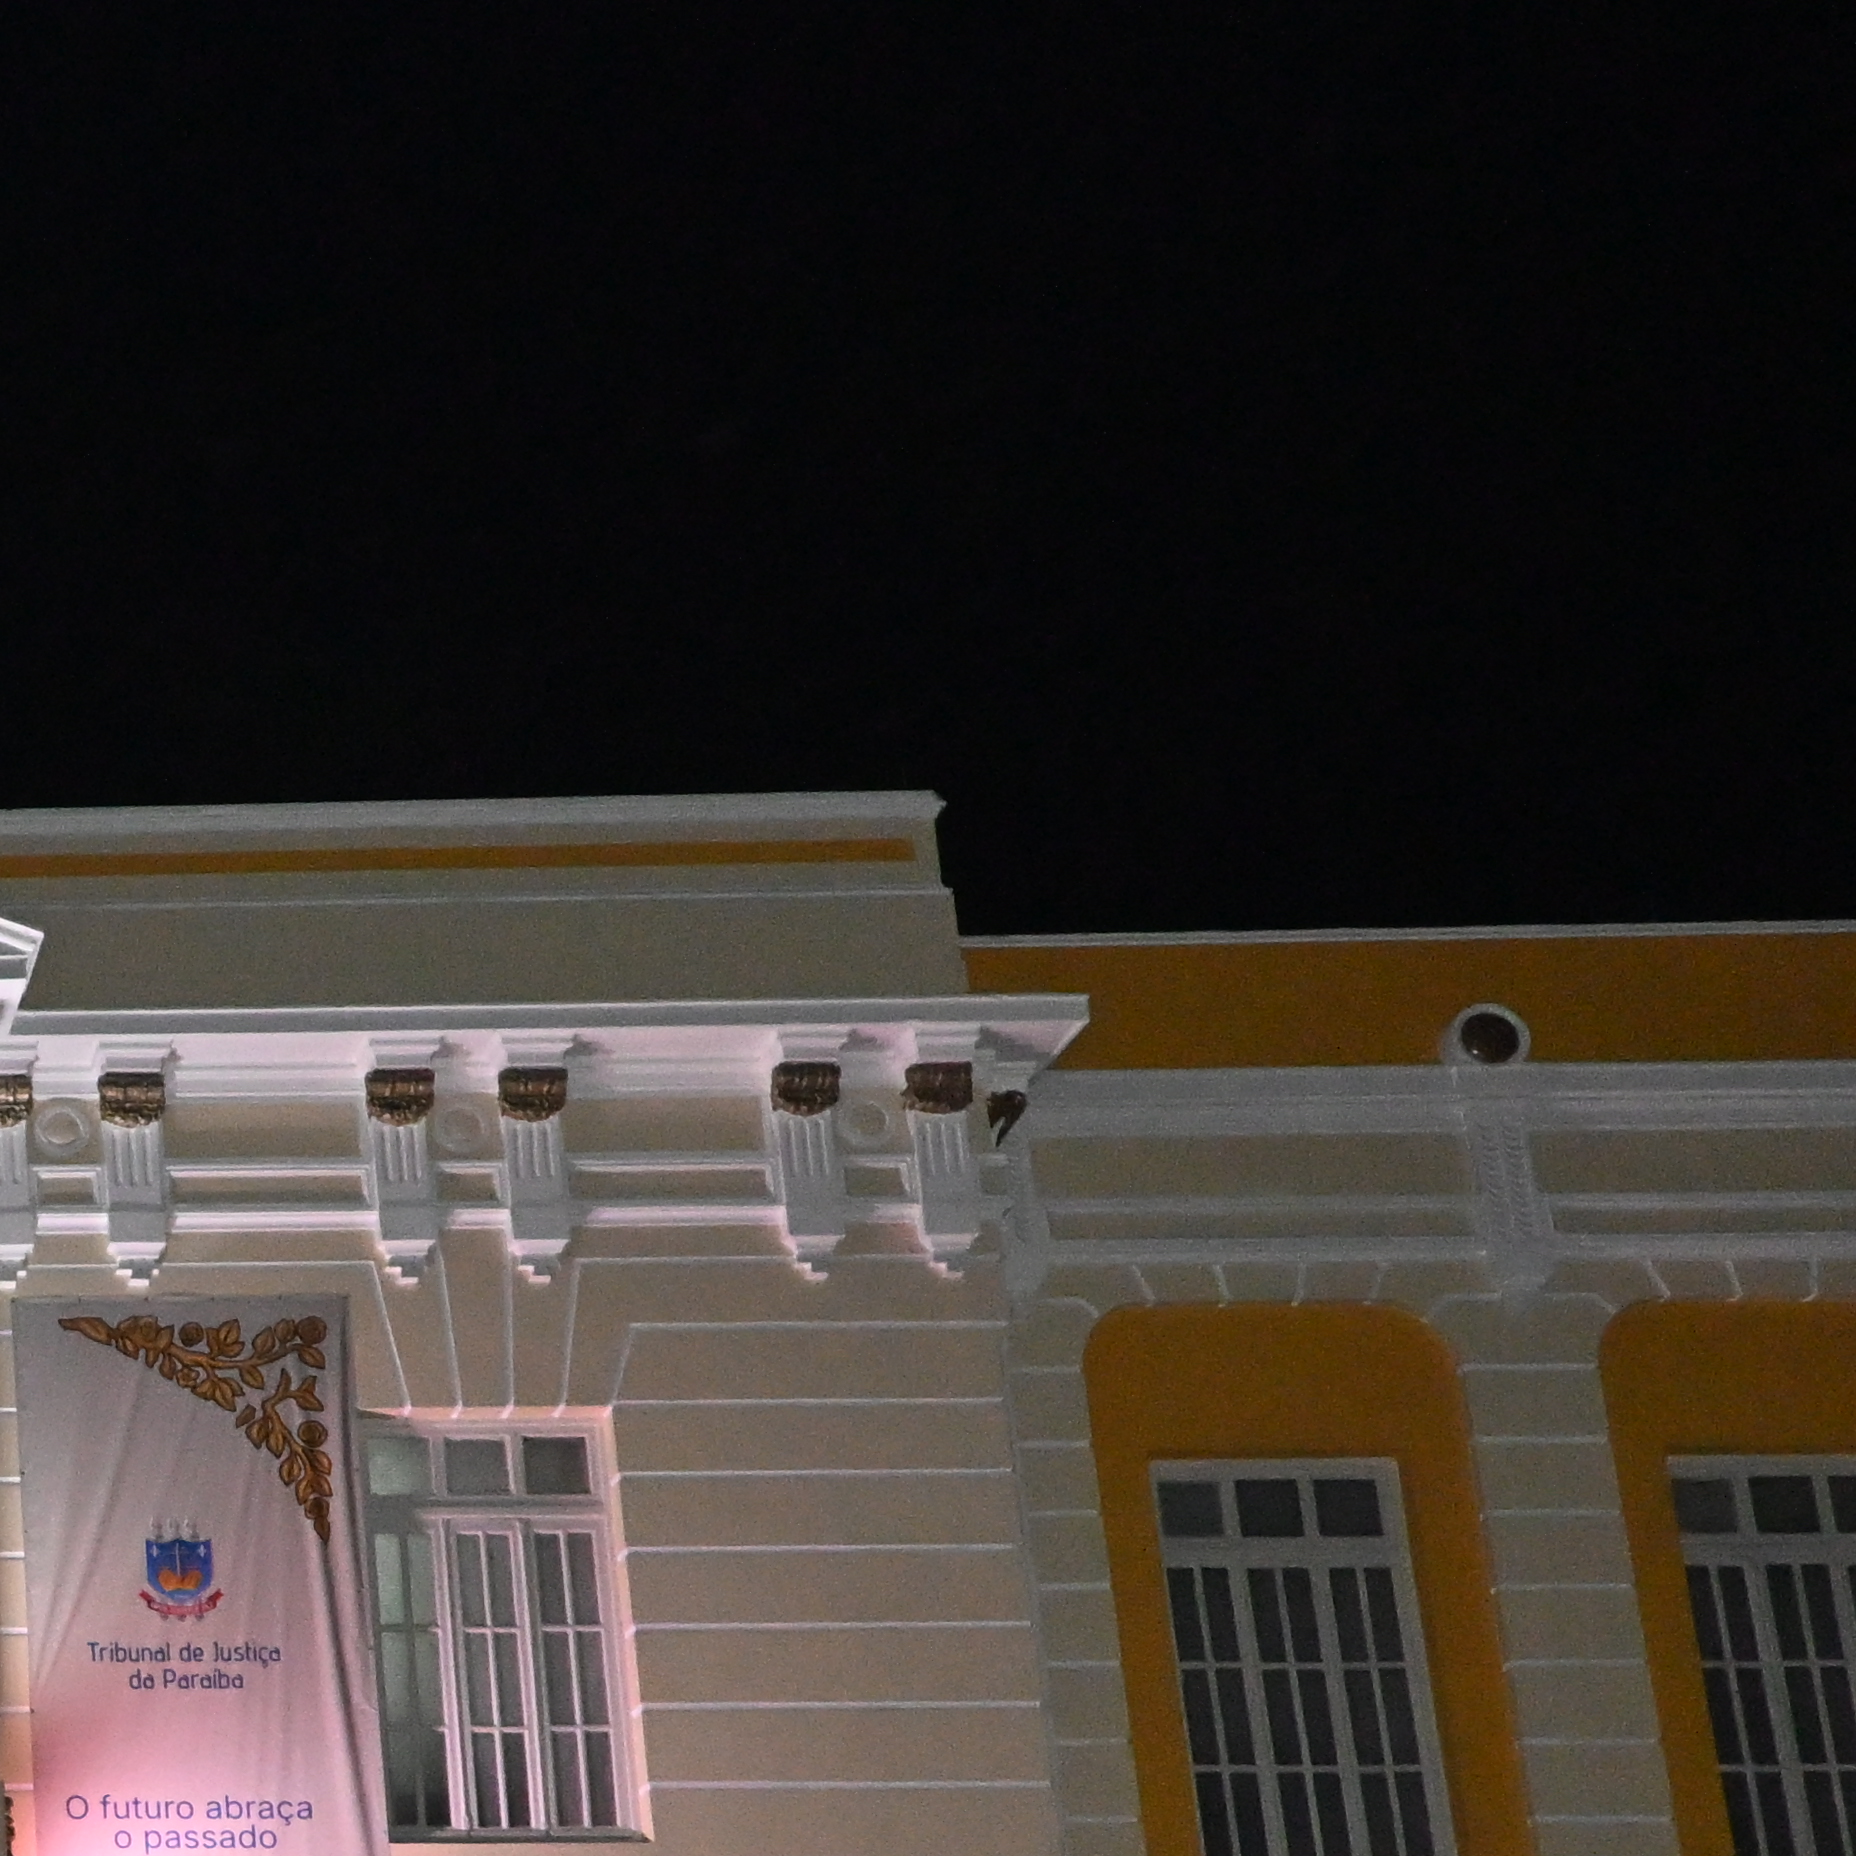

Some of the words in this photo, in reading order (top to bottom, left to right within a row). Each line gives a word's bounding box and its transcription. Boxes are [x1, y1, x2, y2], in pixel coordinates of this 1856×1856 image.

[87, 1641, 171, 1663] Tribunal
[179, 1642, 204, 1662] de
[213, 1641, 282, 1669] Justiça
[129, 1668, 155, 1690] da
[163, 1668, 244, 1690] Paraíba
[66, 1794, 89, 1820] O
[100, 1794, 194, 1820] futuro
[206, 1794, 313, 1826] abraça
[114, 1829, 132, 1849] o
[144, 1824, 277, 1855] passado
